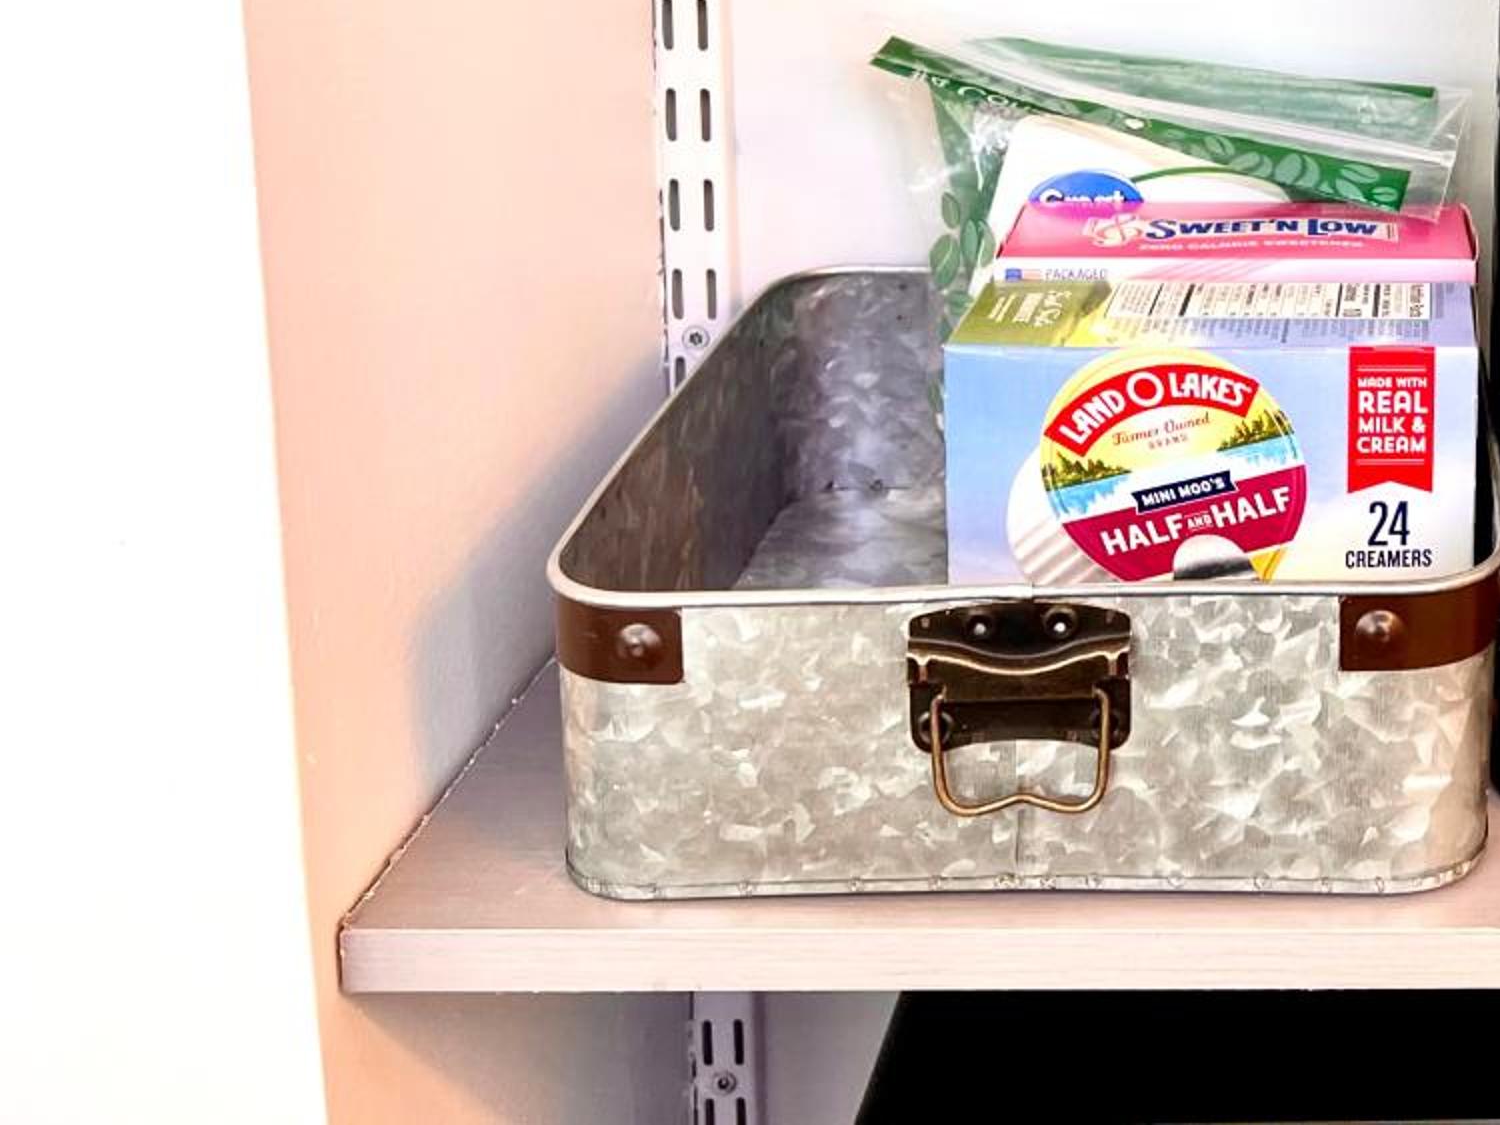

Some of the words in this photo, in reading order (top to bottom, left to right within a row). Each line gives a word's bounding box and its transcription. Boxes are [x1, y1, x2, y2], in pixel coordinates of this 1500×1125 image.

[1357, 376, 1392, 388] MADE
[1395, 376, 1427, 388] WITH
[1059, 390, 1126, 445] LAND
[1126, 371, 1164, 407] O
[1168, 372, 1253, 407] LAKES
[1358, 391, 1428, 414] REAL
[1359, 416, 1406, 434] MILK
[1411, 417, 1426, 434] &
[1357, 436, 1426, 454] CREAM
[1141, 490, 1176, 507] MINI
[1178, 478, 1225, 498] MOO'S
[1100, 514, 1183, 555] HALF
[1187, 515, 1212, 530] AND
[1210, 486, 1291, 527] HALF
[1367, 500, 1410, 546] 24
[1345, 549, 1432, 568] CREAMERS
